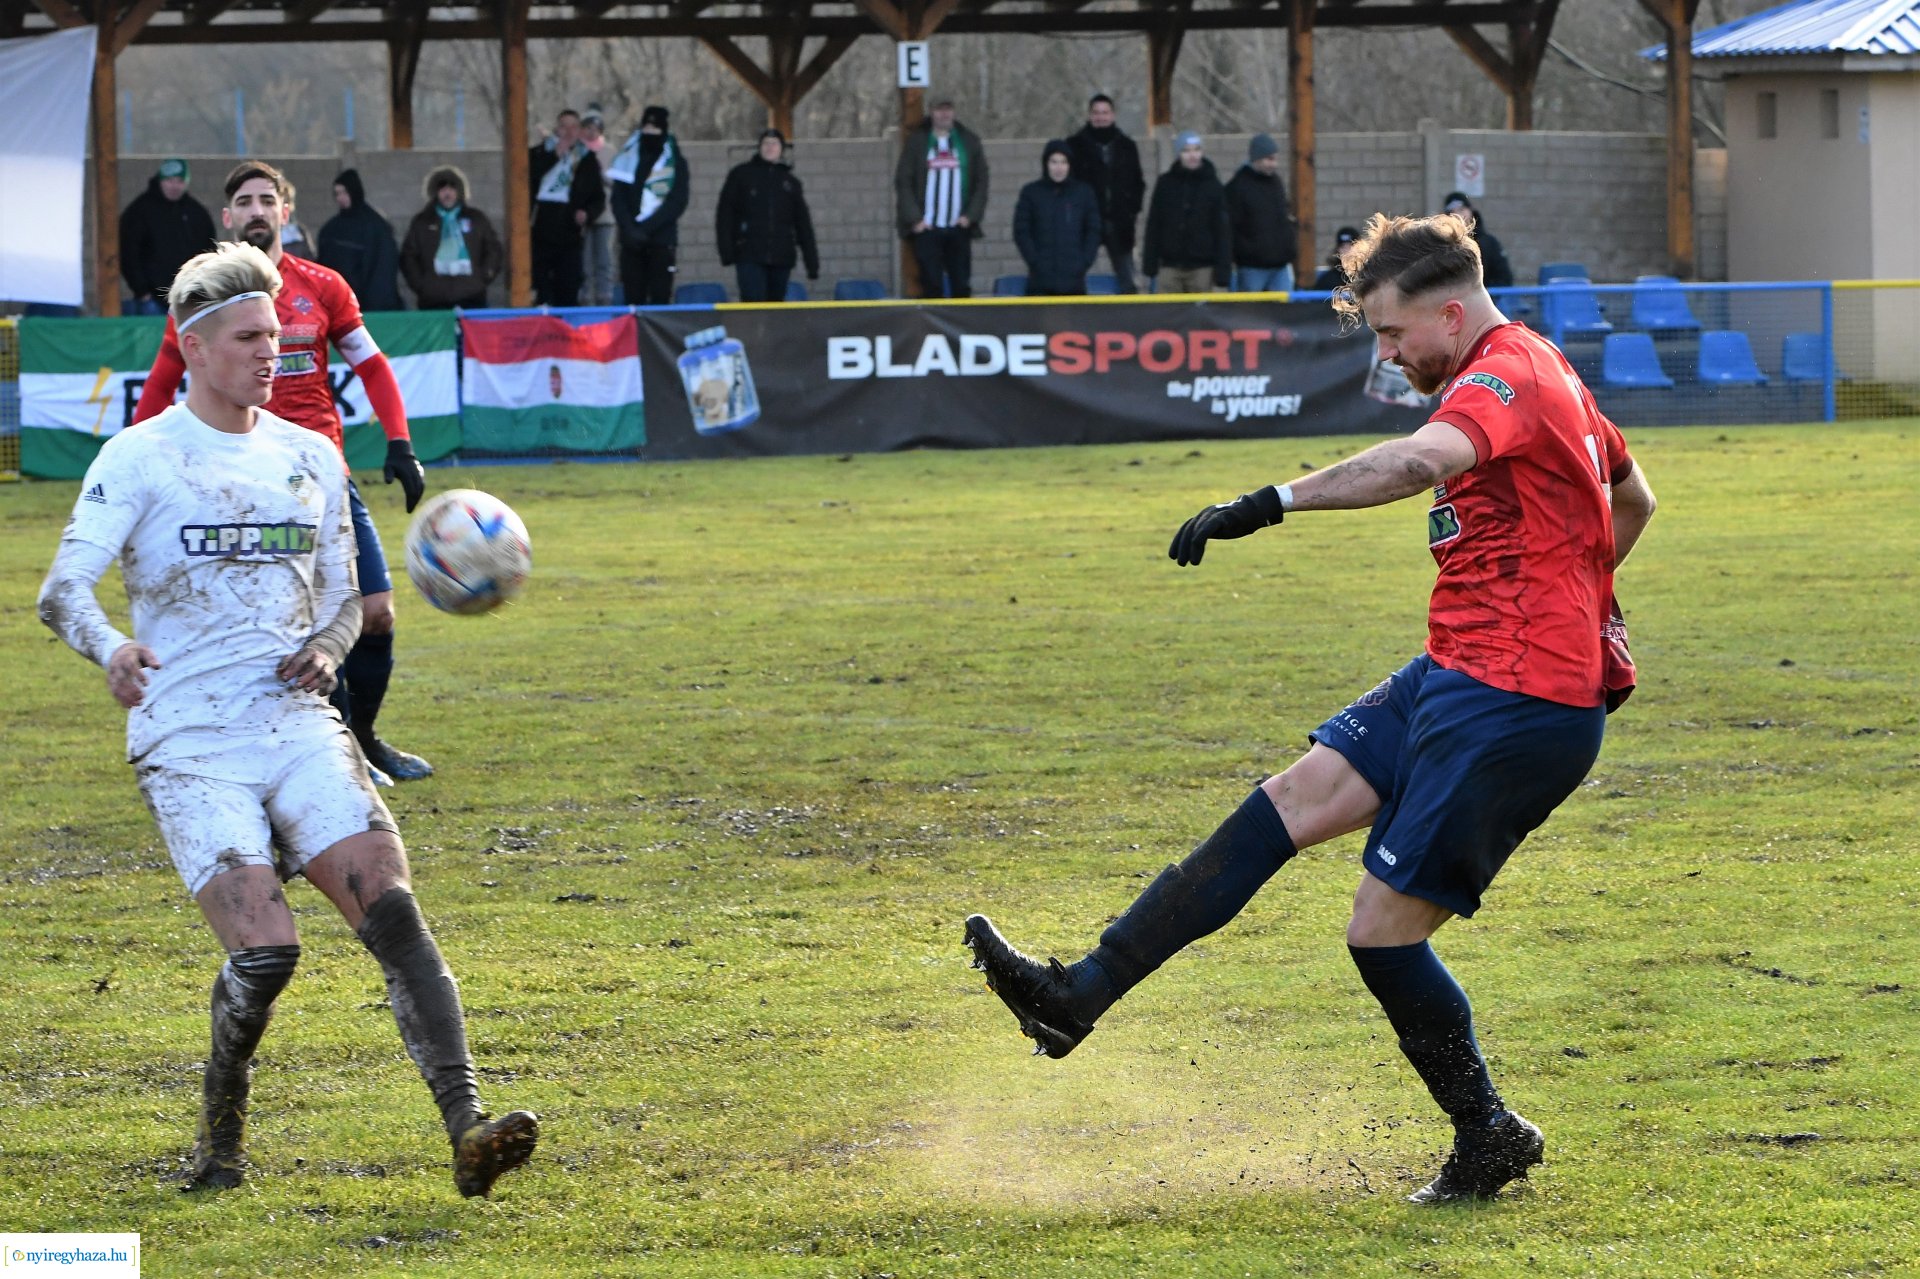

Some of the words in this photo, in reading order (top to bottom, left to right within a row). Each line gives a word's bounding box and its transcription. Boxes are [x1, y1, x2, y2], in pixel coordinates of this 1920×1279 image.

[907, 46, 921, 81] E
[827, 329, 1272, 379] BLADESPORT
[1167, 380, 1192, 397] the
[1192, 375, 1271, 402] power
[1225, 395, 1302, 422] yours!
[1339, 709, 1368, 737] TIGE
